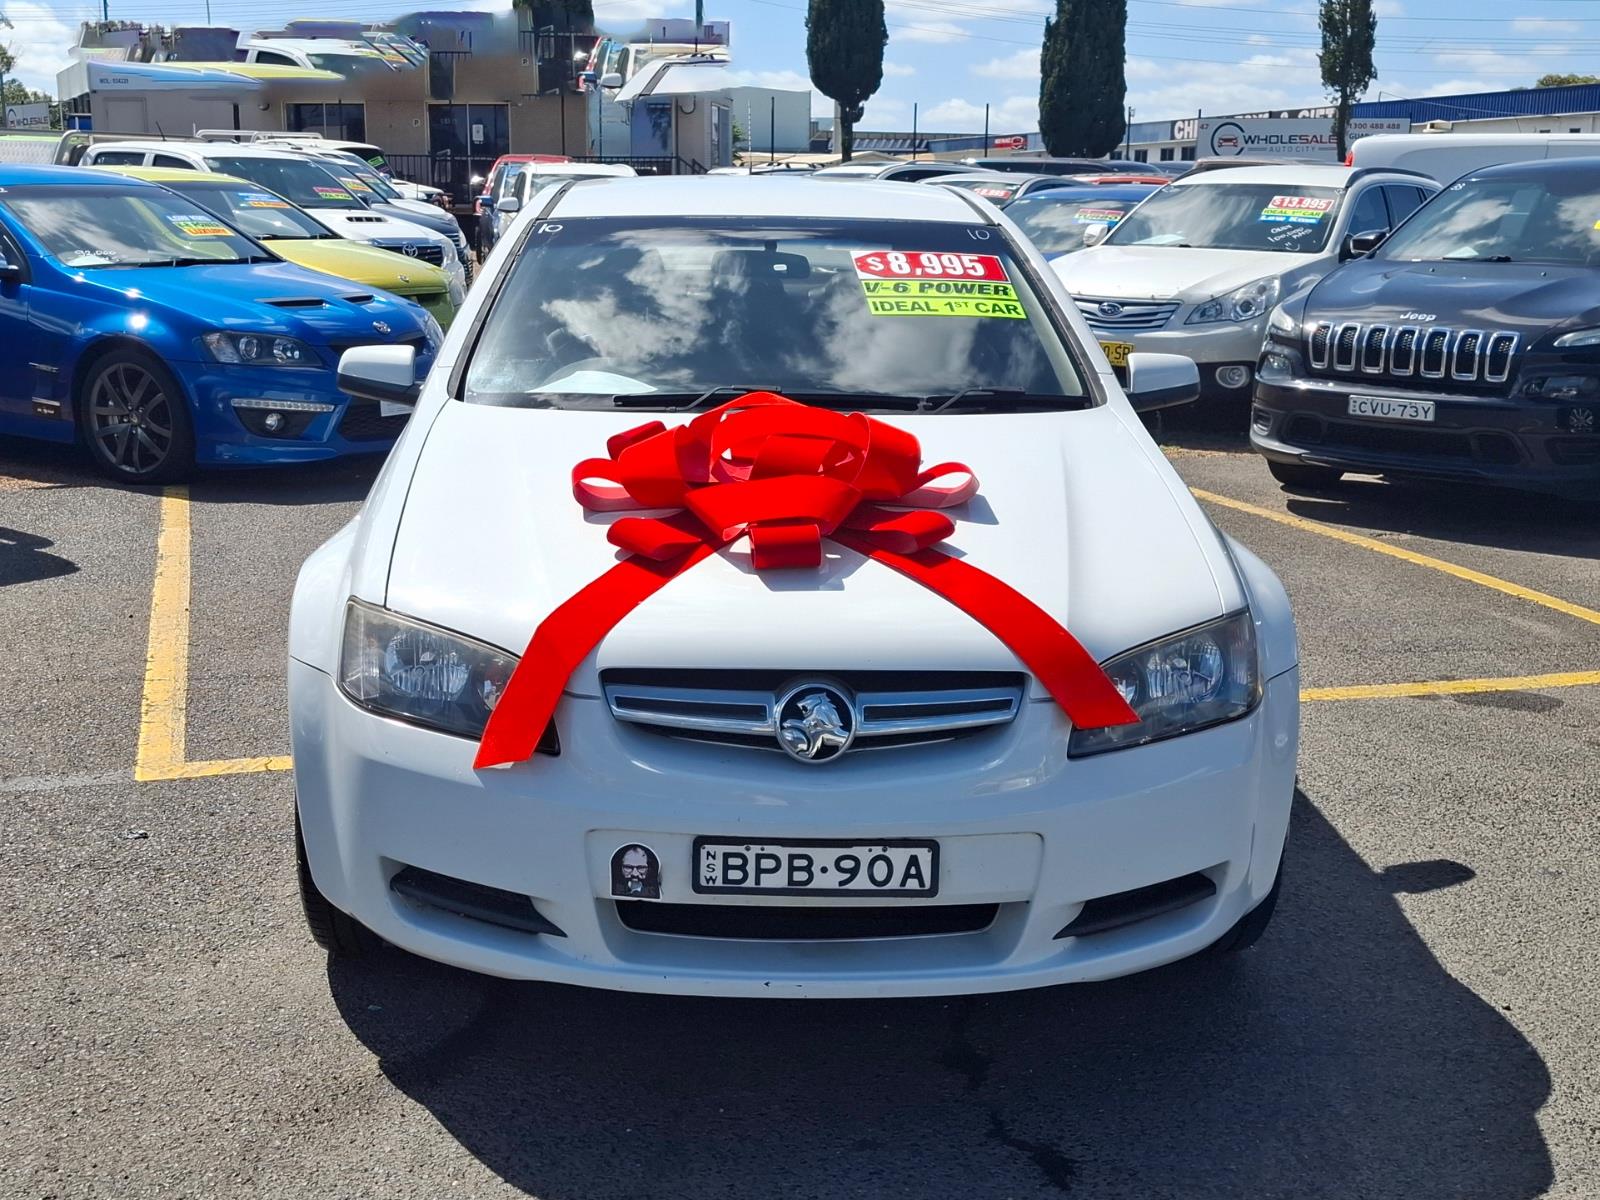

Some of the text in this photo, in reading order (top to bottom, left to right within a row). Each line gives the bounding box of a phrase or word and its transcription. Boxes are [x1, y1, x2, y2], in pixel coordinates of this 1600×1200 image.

[1349, 122, 1367, 130] 1300
[1243, 135, 1338, 145] WHOLESALE
[538, 223, 564, 234] 10
[966, 228, 990, 240] 10
[865, 252, 985, 277] $8,995
[864, 281, 1010, 296] V-6 POWER
[872, 300, 939, 313] IDEAL
[974, 303, 1022, 316] CAR
[1400, 311, 1437, 321] Jeep
